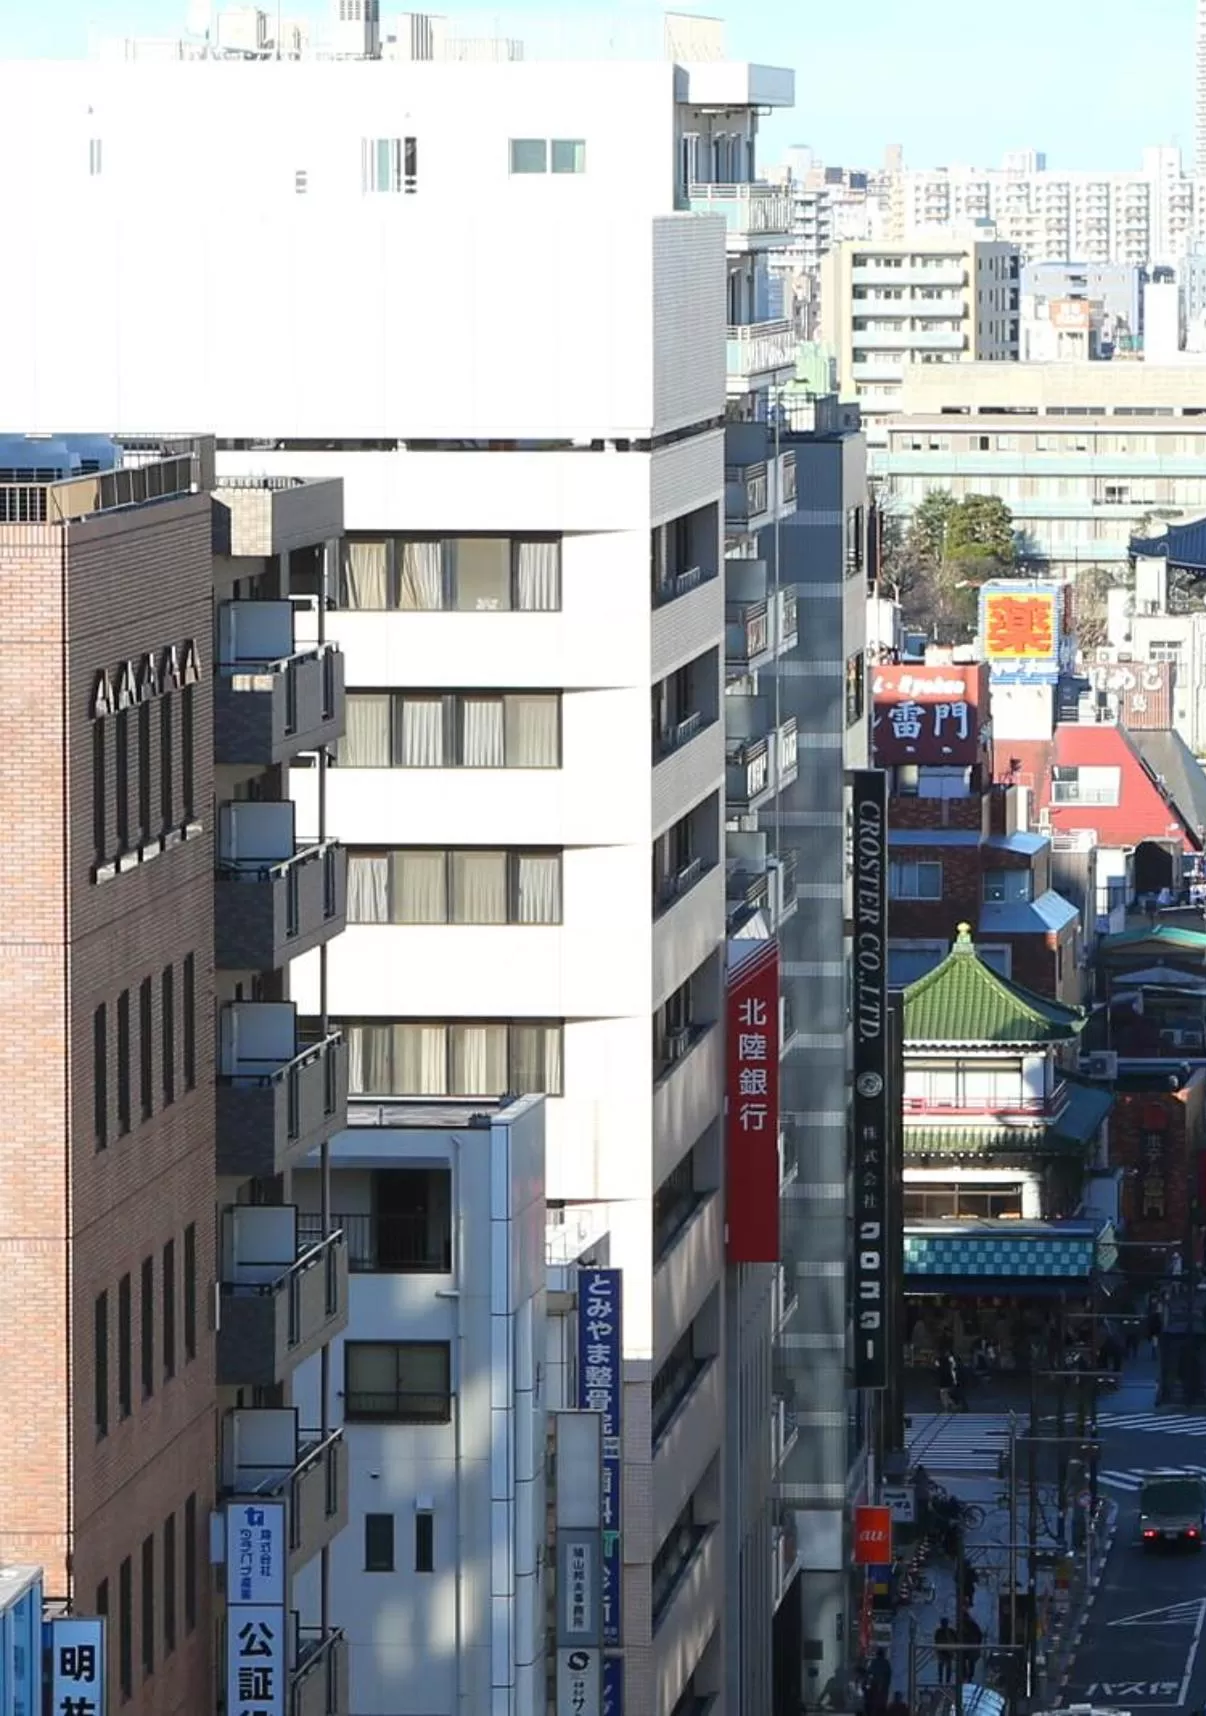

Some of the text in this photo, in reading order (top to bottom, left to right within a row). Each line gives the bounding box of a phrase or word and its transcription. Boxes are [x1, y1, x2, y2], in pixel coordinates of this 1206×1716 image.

[988, 596, 1051, 653] 薬
[859, 800, 881, 925] CROSTER
[738, 997, 768, 1132] 北陸銀行
[859, 1125, 881, 1361] 株式会社 クロスター
[238, 1622, 275, 1716] 公証
